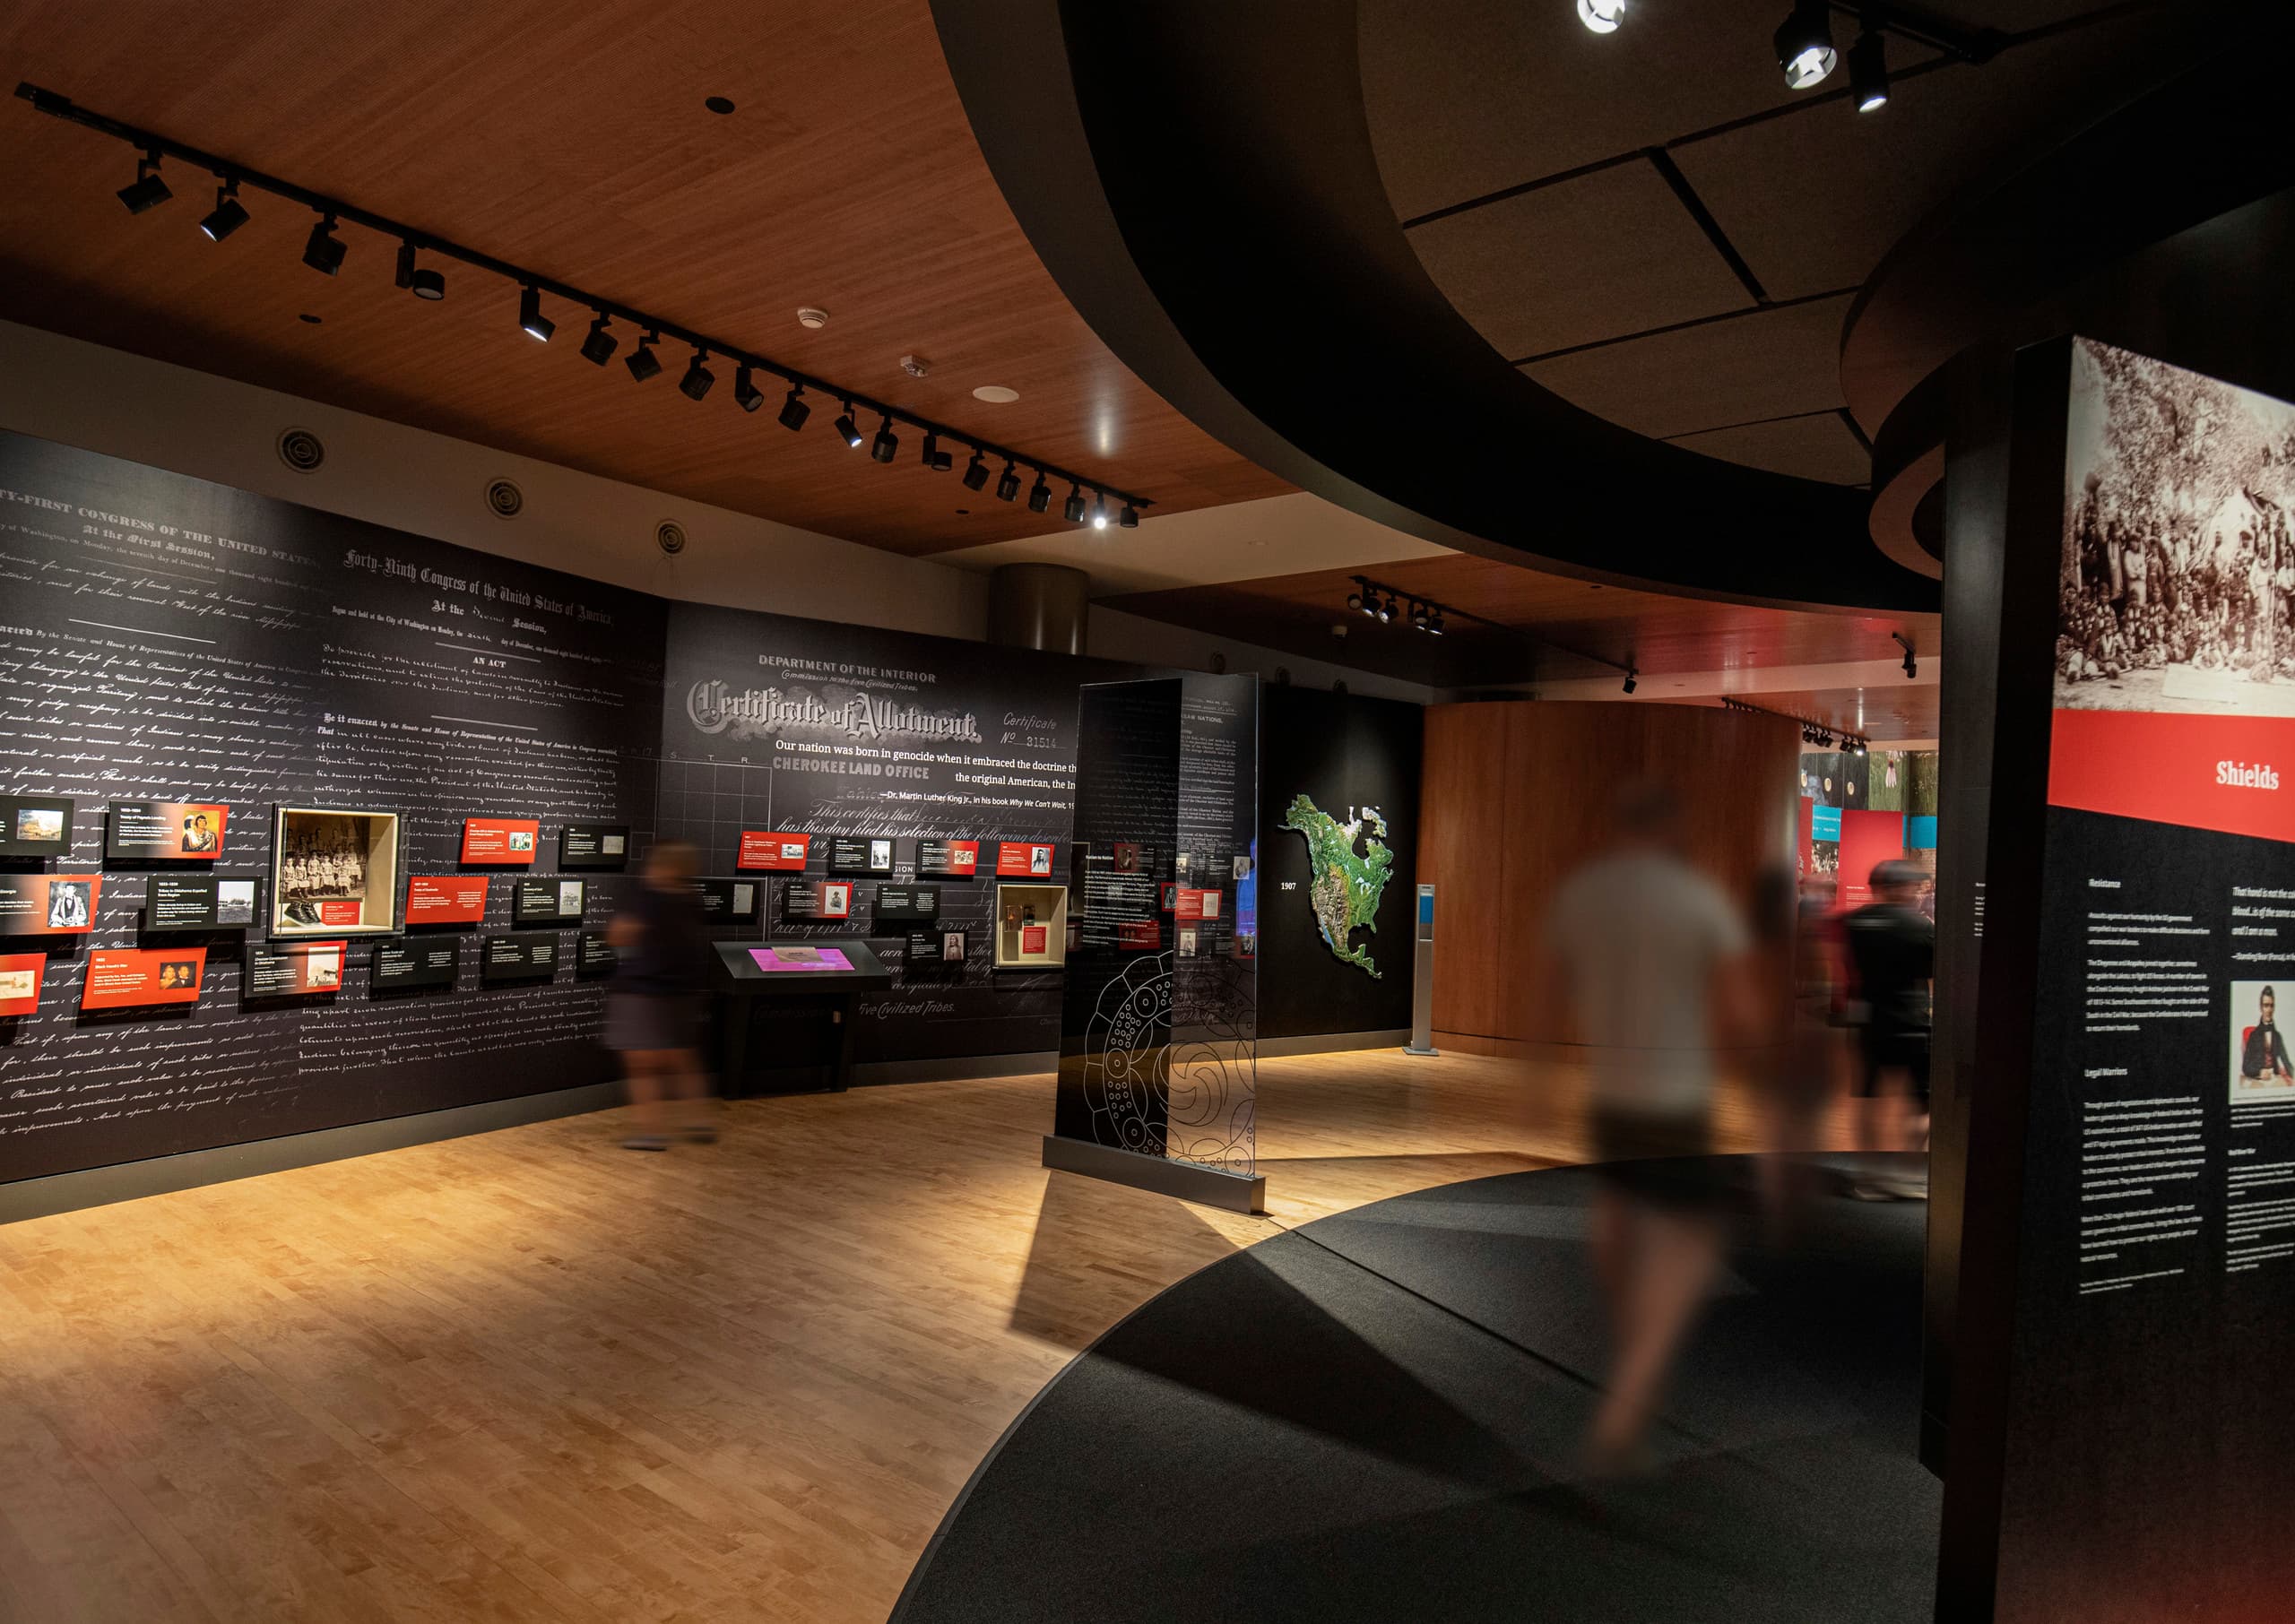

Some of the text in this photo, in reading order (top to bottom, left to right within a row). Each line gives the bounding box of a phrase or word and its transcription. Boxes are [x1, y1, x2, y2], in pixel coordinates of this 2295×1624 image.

[78, 507, 155, 531] CONGRESS
[160, 525, 178, 536] OF
[183, 531, 212, 544] THE
[218, 538, 268, 556] UNITED
[343, 549, 417, 583] Forty-Ninth
[421, 567, 466, 591] Congress
[470, 581, 481, 594] of
[484, 583, 496, 601] the
[500, 586, 531, 606] United
[533, 595, 563, 614] States
[565, 603, 574, 617] of
[431, 600, 446, 612] At
[449, 604, 464, 615] the
[512, 618, 547, 635] Session,
[488, 659, 507, 668] ACT
[759, 654, 936, 683] DEPARTMENT OF THE INTERIOR
[687, 679, 827, 734] Certificate
[1003, 712, 1057, 730] Certificate
[773, 756, 930, 779] CHEROKEE LAND OFFICE
[775, 739, 796, 750] Our
[799, 741, 831, 754] nation
[835, 747, 853, 756] was
[855, 746, 879, 756] born
[881, 747, 891, 757] in
[893, 751, 934, 762] genocide
[937, 754, 961, 764] when
[964, 755, 971, 764] it
[973, 757, 1015, 769] embraced
[1018, 759, 1030, 769] the
[1033, 761, 1066, 773] doctrine
[956, 773, 970, 782] the
[972, 773, 1006, 786] original
[1008, 776, 1050, 790] American,
[1052, 780, 1065, 789] the
[2216, 760, 2280, 790] Shields
[809, 799, 917, 825] This certifies that
[899, 791, 922, 800] Martin
[924, 793, 946, 801] Luther
[947, 795, 962, 805] King
[992, 798, 1009, 806] book
[1009, 799, 1023, 808] Why
[775, 816, 801, 832] has
[801, 818, 825, 834] this
[825, 820, 850, 836] day
[850, 821, 880, 836] filed
[881, 822, 899, 837] his
[900, 823, 946, 840] selection
[974, 825, 1028, 842] following
[1280, 882, 1296, 890] 1907
[877, 1002, 923, 1020] Civilized
[922, 1000, 955, 1016] Tribes.
